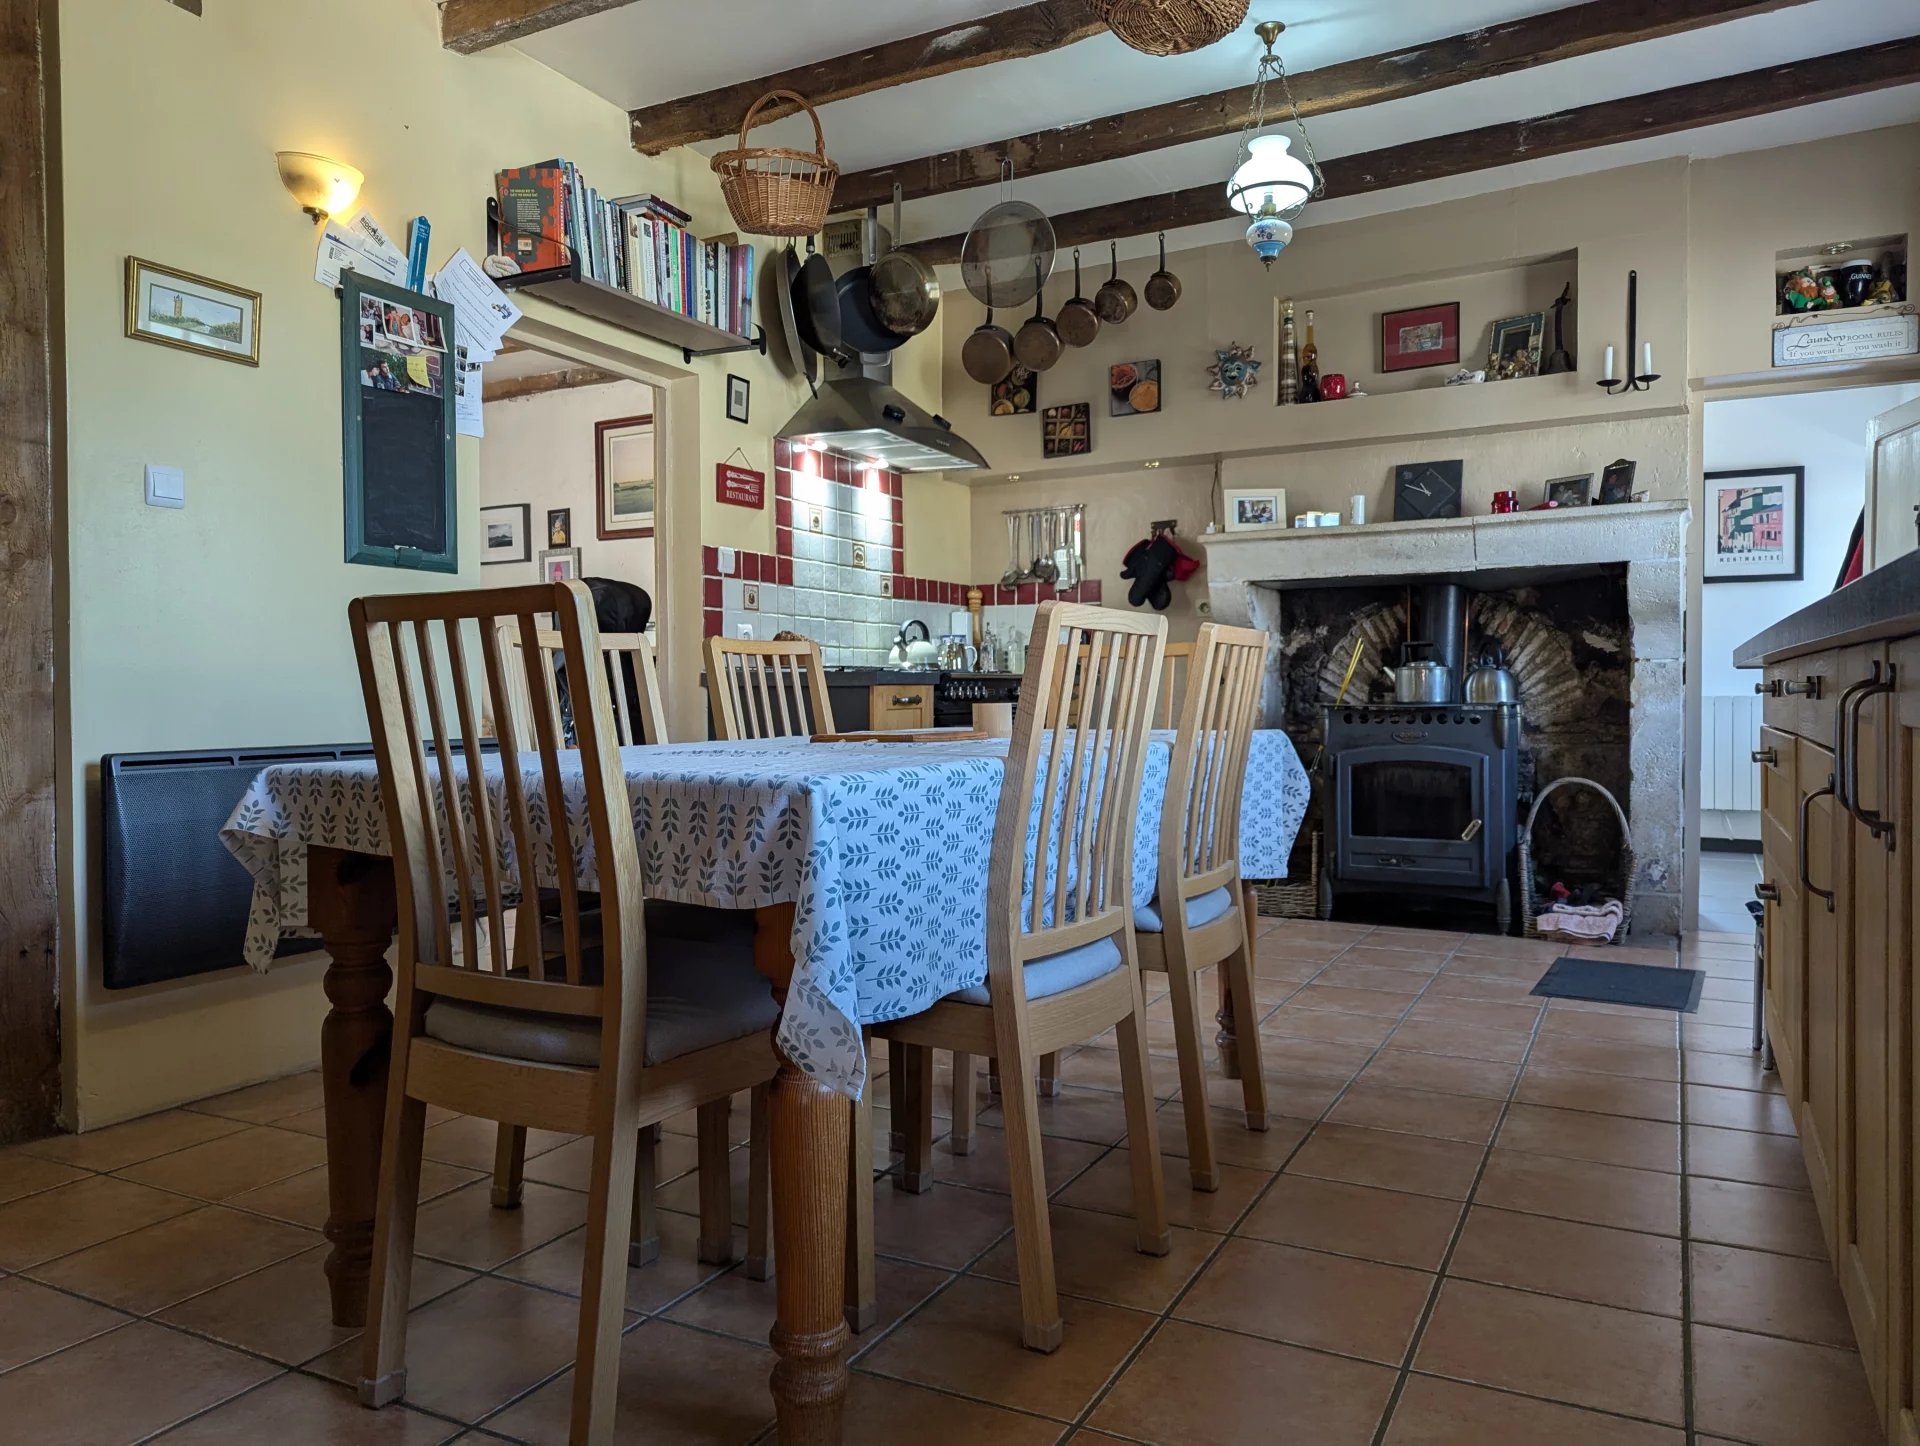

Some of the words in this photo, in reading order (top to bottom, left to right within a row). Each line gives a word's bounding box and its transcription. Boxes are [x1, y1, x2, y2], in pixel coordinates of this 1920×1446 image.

[1787, 331, 1846, 352] Laundry
[1847, 333, 1873, 341] ROOM
[1877, 330, 1903, 338] RULES
[1816, 347, 1836, 355] wear
[1854, 345, 1870, 353] you
[1872, 341, 1893, 349] wash
[726, 489, 759, 503] RESTAURANT
[1719, 555, 1780, 563] MONTMARTRE
